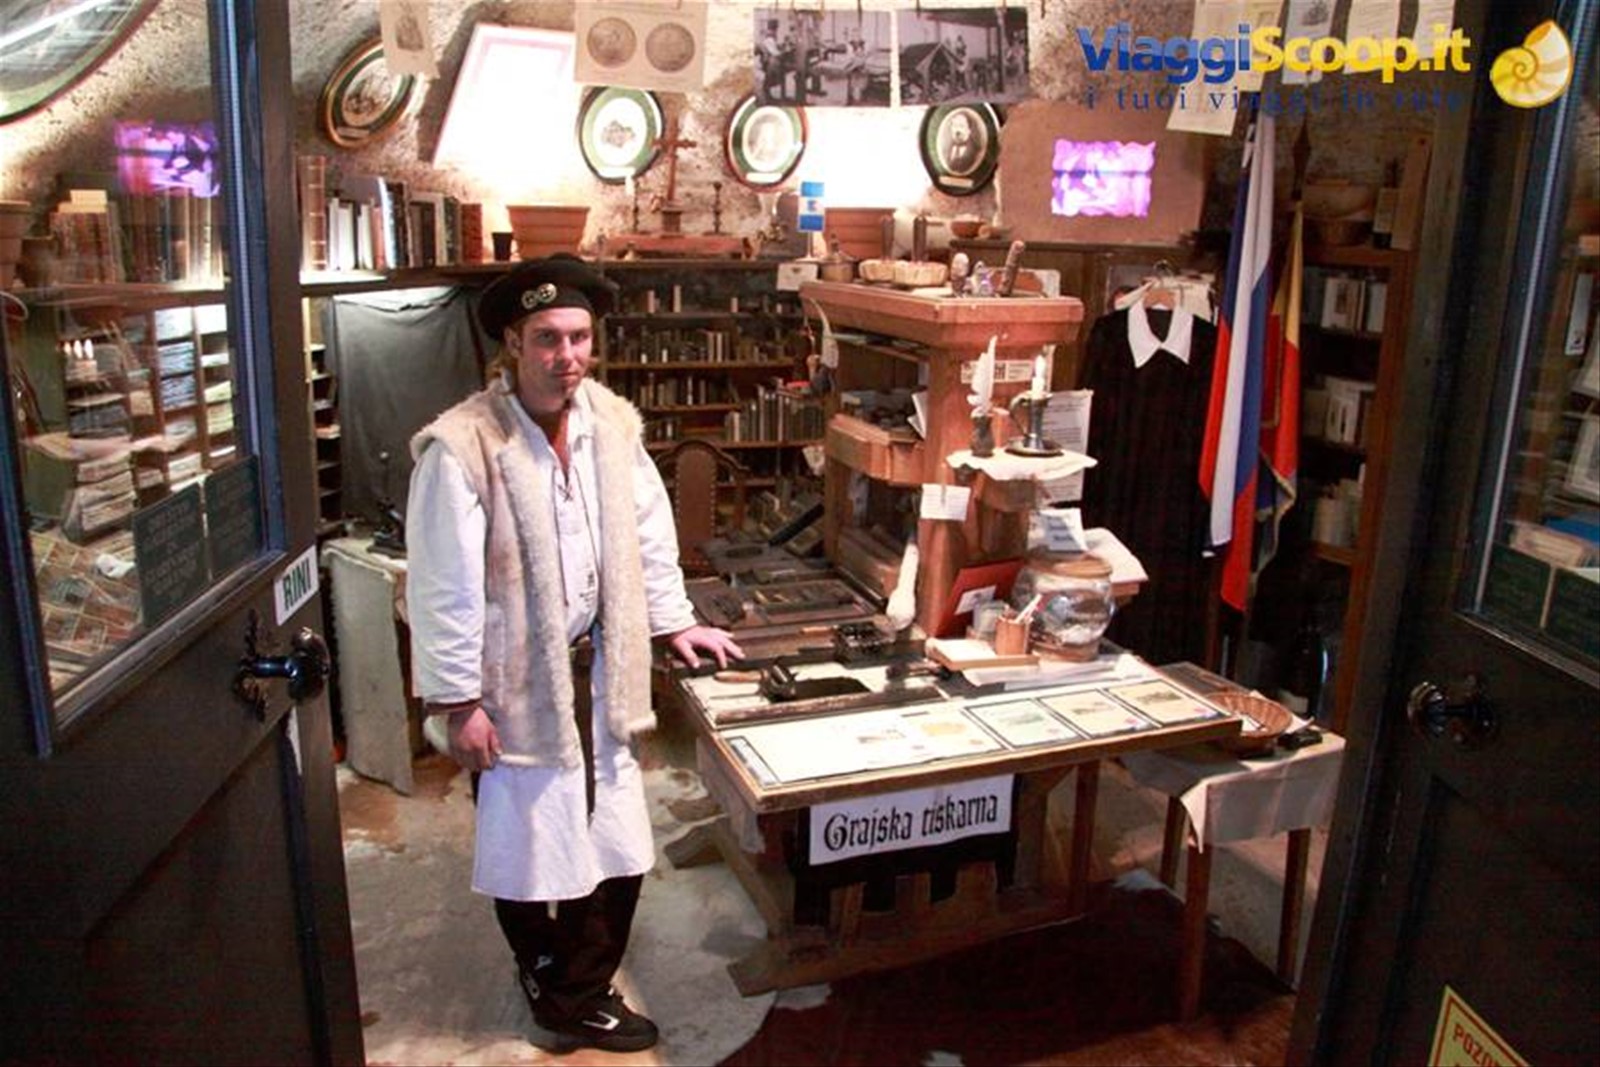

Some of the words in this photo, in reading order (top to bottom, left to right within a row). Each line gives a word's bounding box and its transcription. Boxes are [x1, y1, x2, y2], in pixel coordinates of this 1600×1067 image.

[824, 807, 912, 851] Grajska
[920, 793, 998, 838] tiskarna
[1452, 1023, 1501, 1067] POZO
